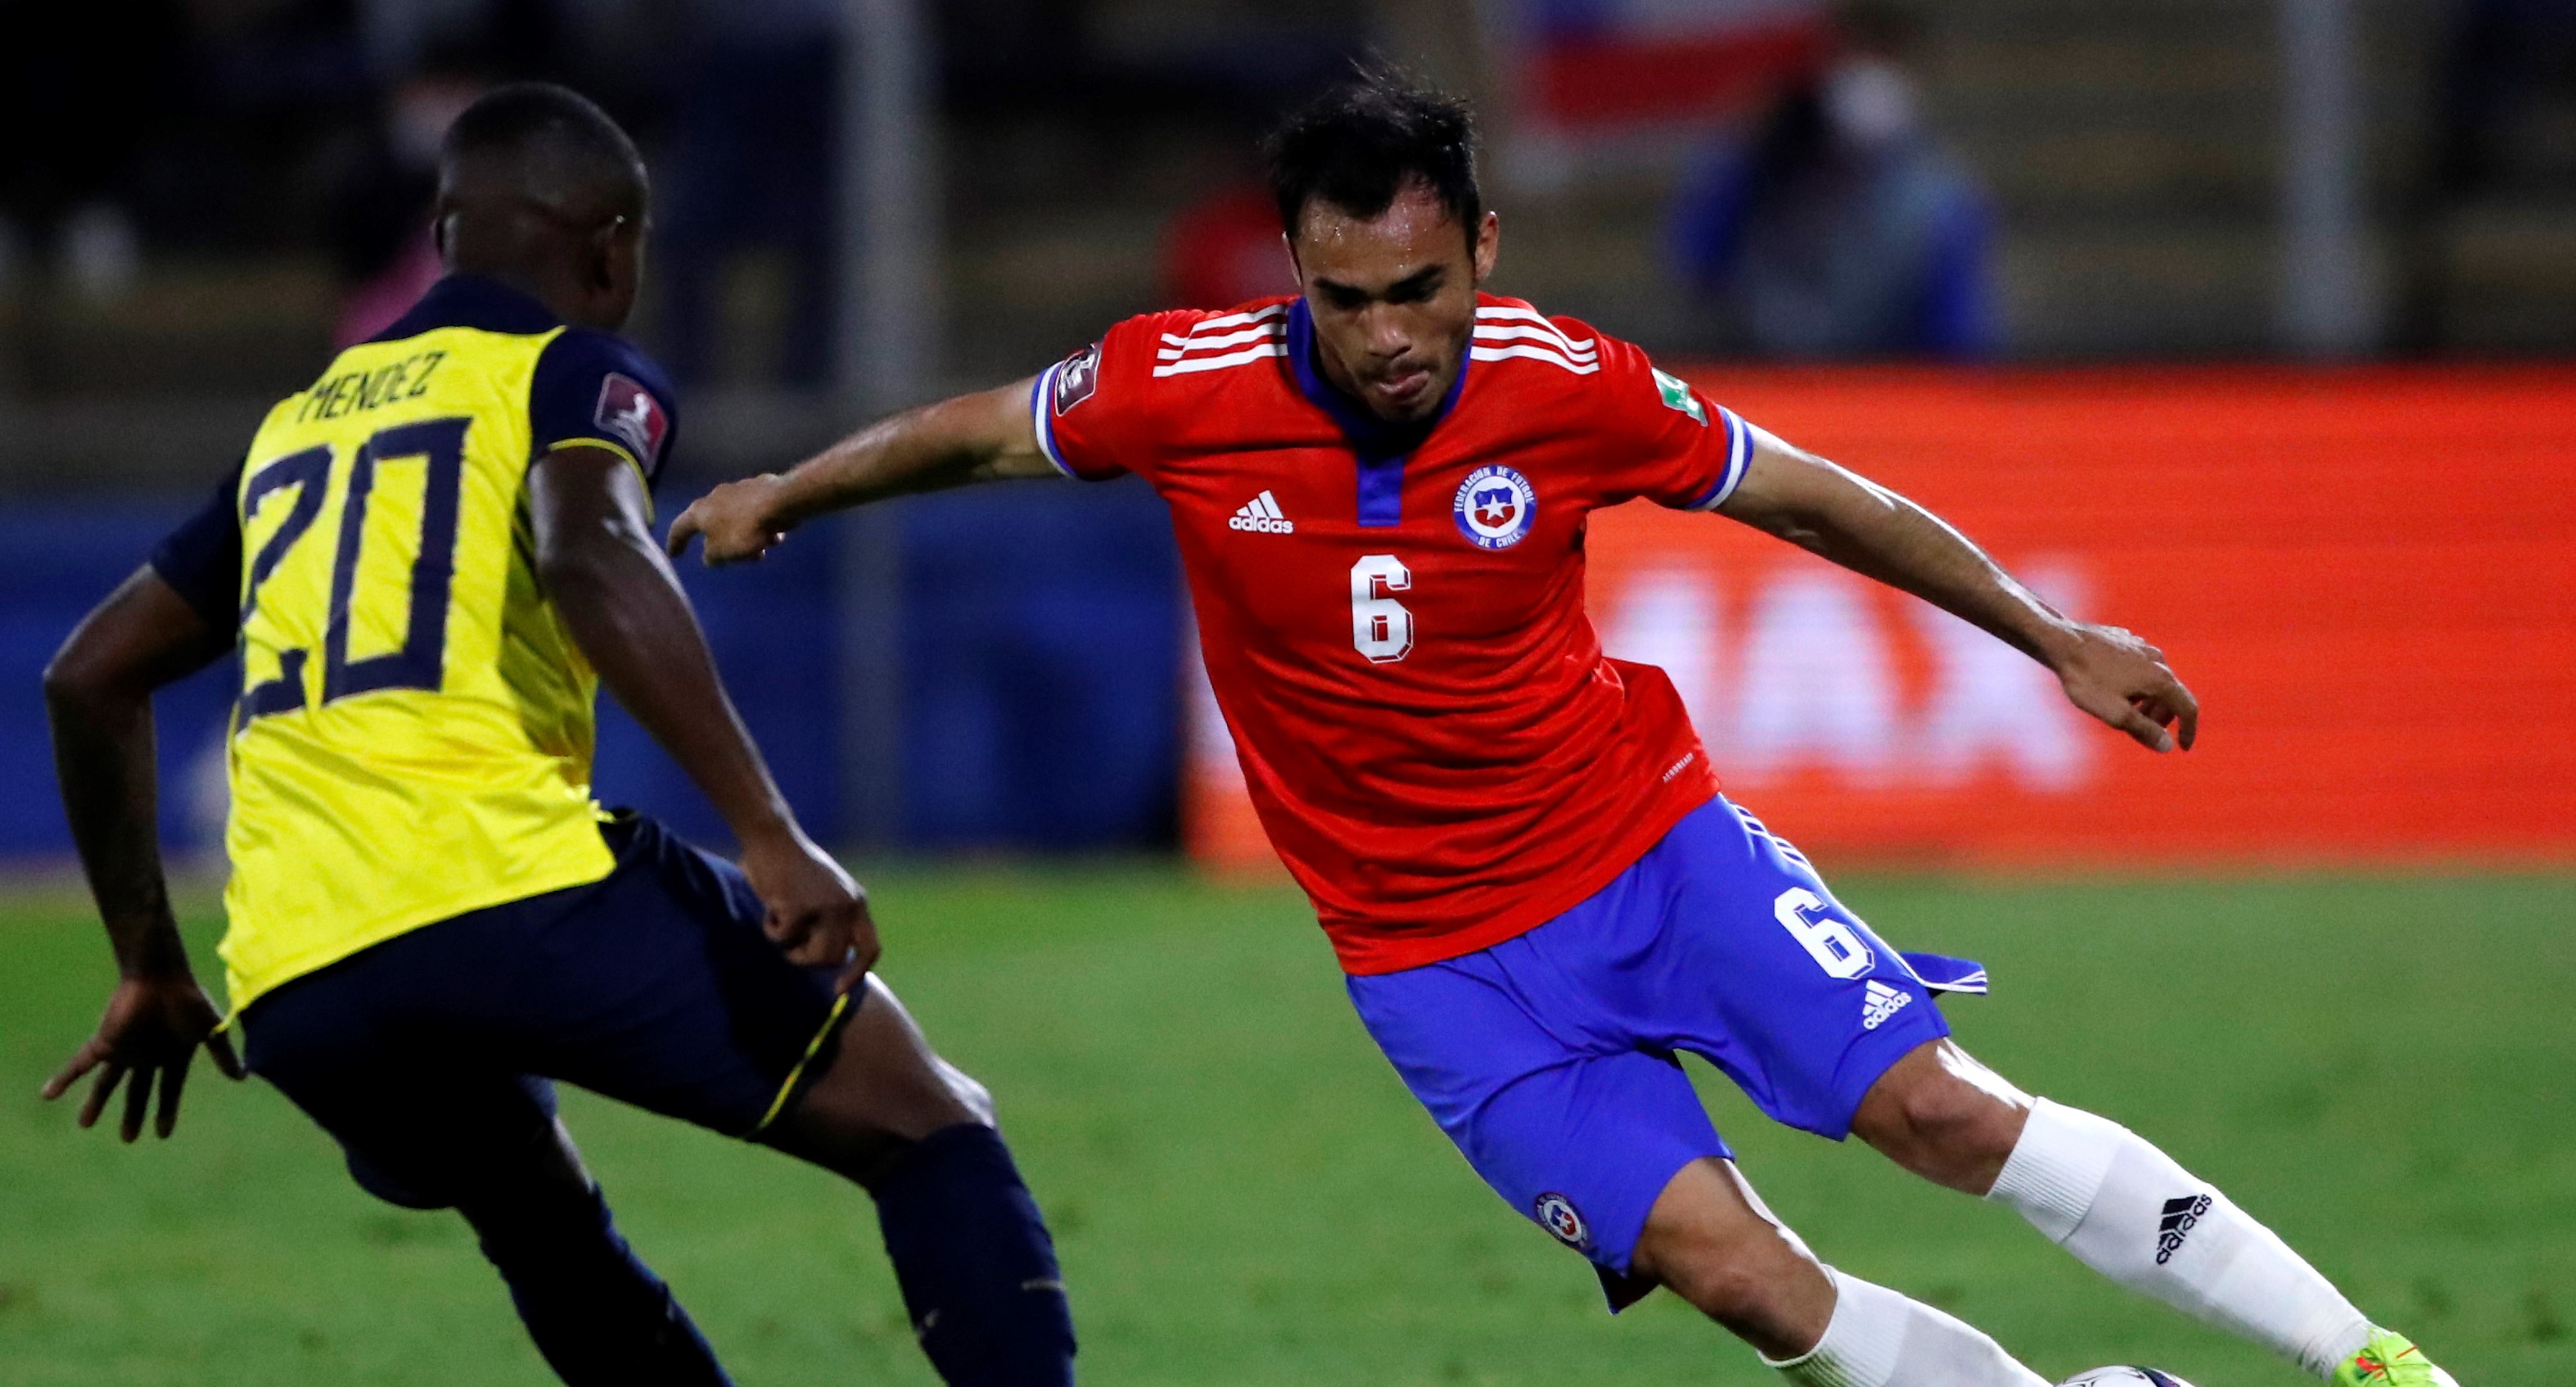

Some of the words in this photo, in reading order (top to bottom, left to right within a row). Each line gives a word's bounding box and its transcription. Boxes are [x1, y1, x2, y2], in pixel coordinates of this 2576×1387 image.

[297, 350, 447, 424] MENDEZ
[1496, 465, 1509, 477] DE
[1229, 514, 1294, 534] adidas
[1477, 536, 1491, 548] DE
[1496, 531, 1522, 549] CHILE
[239, 416, 472, 734] 20
[1350, 554, 1414, 664] 6
[1774, 886, 1874, 980] 6
[1862, 992, 1912, 1030] adidas
[2156, 1194, 2212, 1265] adidas
